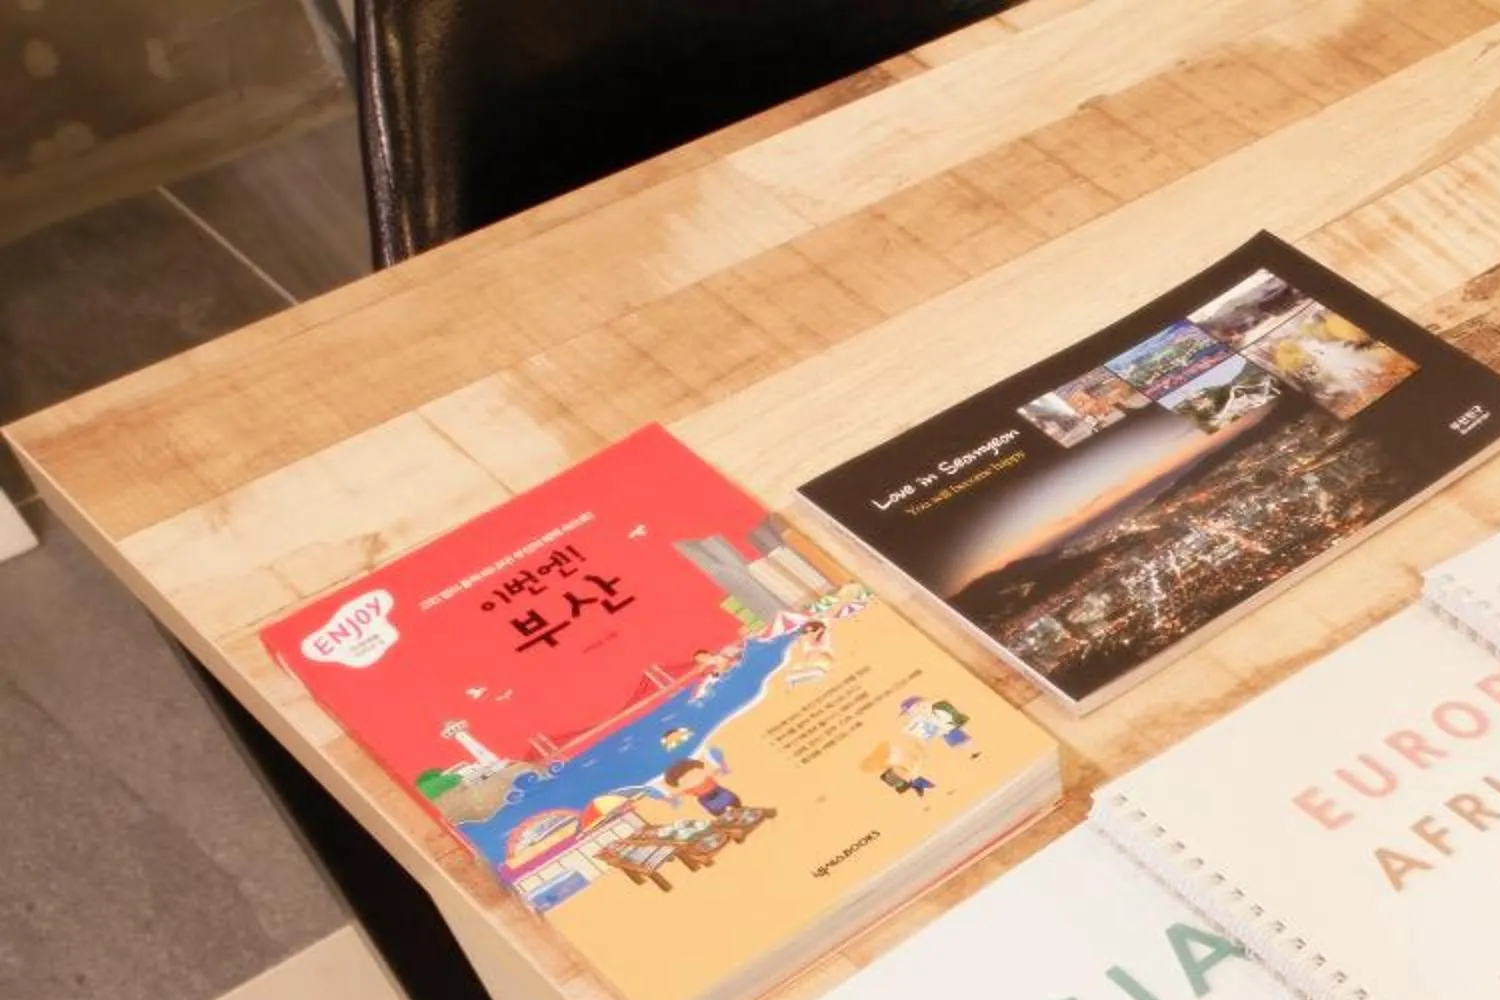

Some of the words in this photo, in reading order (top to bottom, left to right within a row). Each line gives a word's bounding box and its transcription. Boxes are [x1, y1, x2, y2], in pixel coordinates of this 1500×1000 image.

[870, 484, 916, 511] Love
[916, 473, 938, 487] in
[480, 545, 587, 612] 이번엔!
[312, 597, 382, 656] ENJOY
[514, 574, 636, 653] 부산
